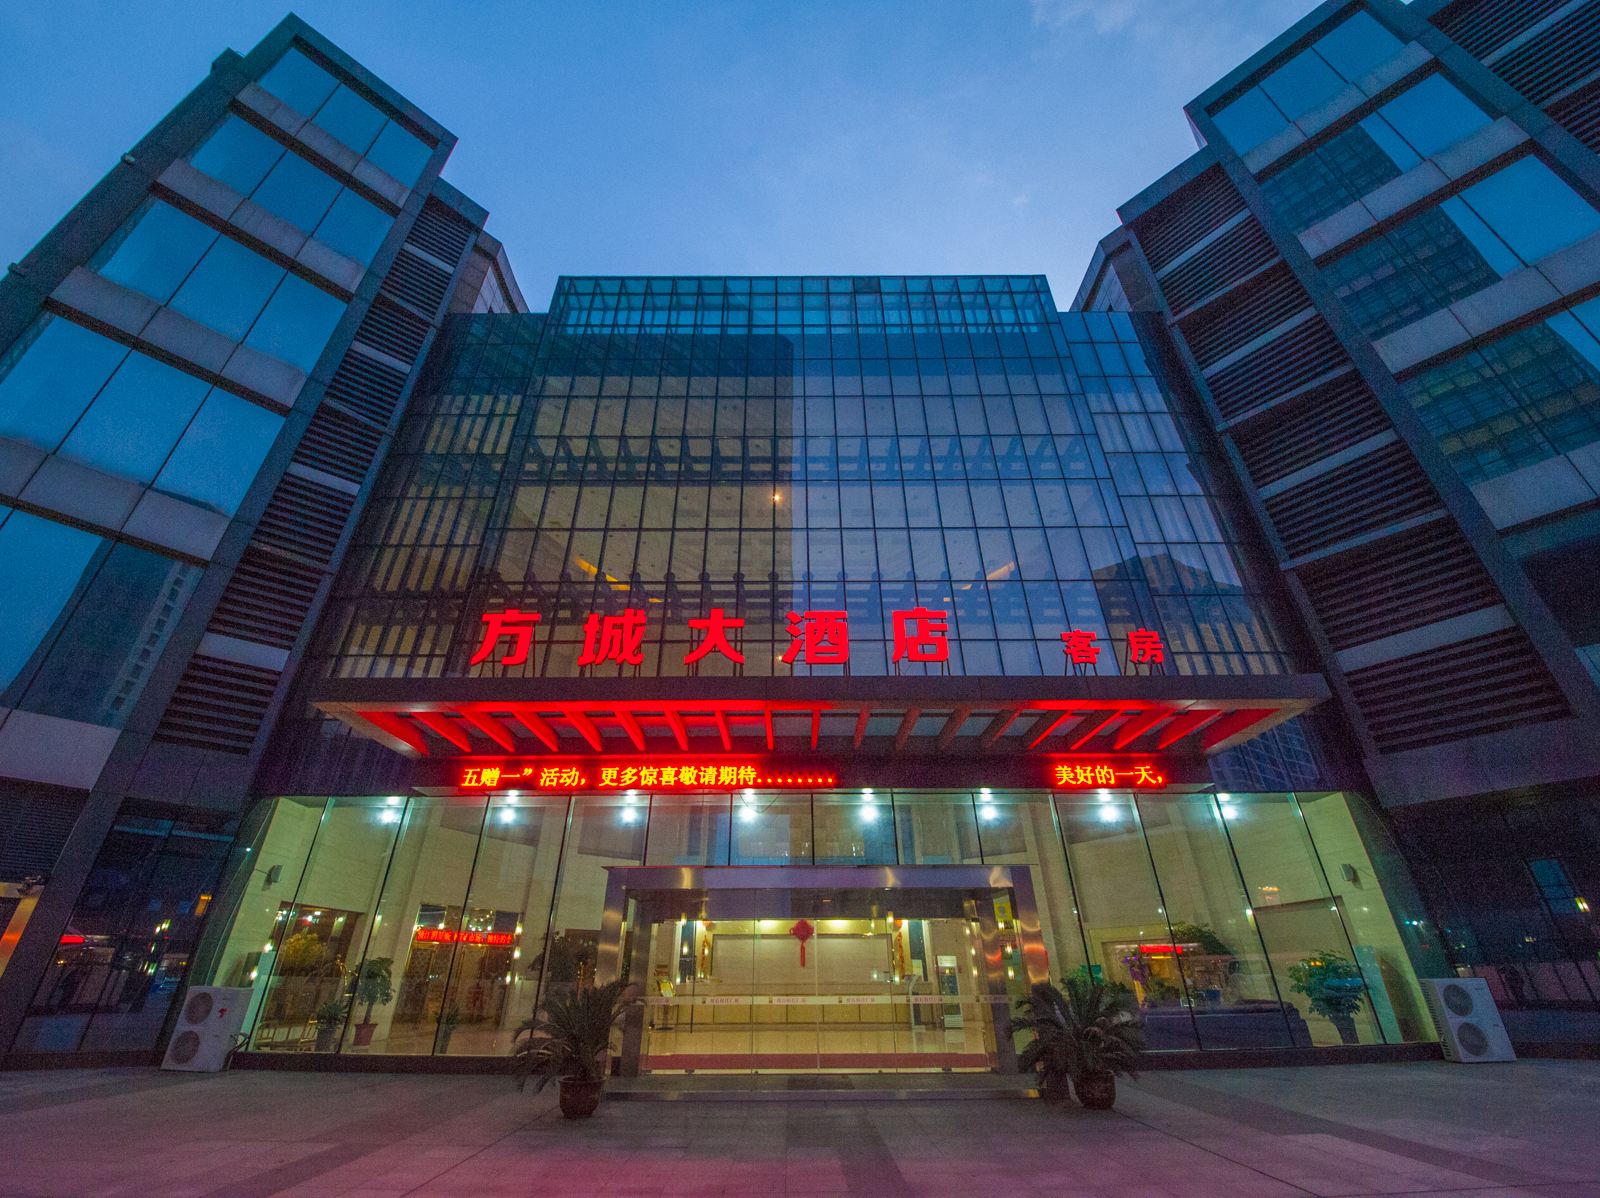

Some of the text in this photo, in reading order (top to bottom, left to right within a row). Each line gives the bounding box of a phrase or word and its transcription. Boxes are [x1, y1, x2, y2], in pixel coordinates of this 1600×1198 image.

[470, 608, 950, 665] 方城大酒店
[1061, 628, 1165, 664] 客房
